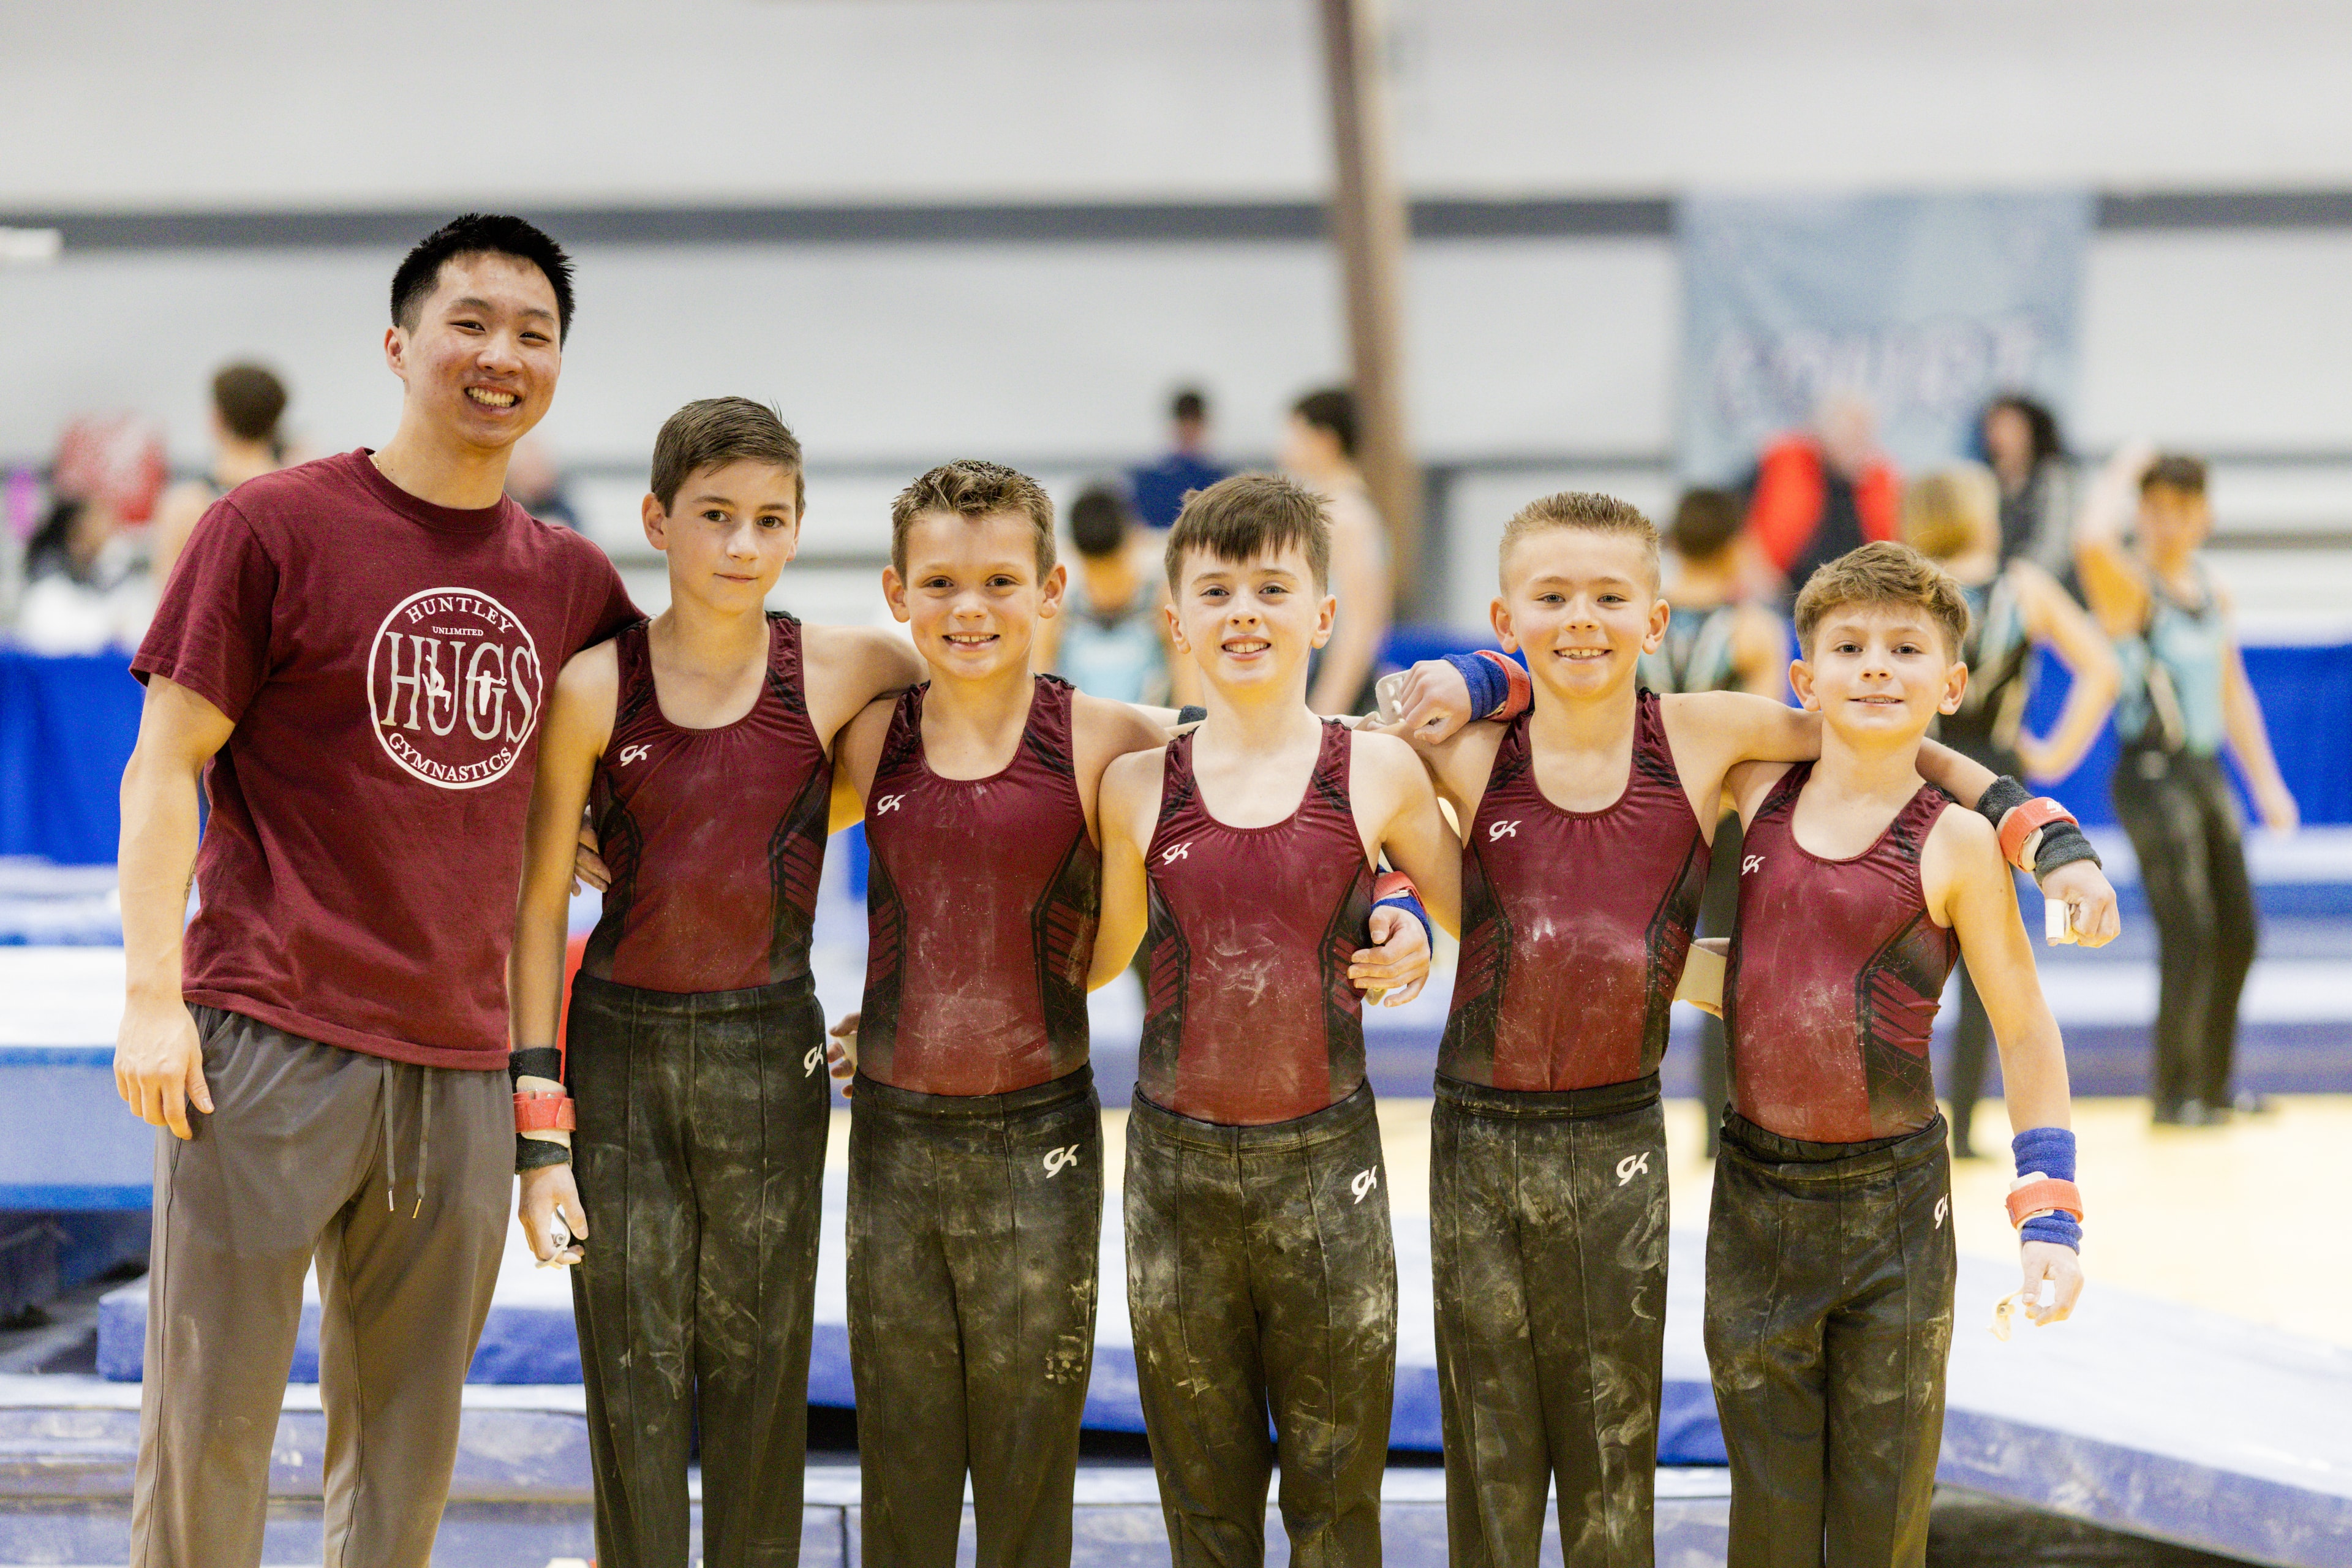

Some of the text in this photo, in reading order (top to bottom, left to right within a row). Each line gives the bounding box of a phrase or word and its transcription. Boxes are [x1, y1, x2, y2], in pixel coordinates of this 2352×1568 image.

[405, 597, 514, 633] HUNTLEY
[432, 626, 484, 636] UNLIMITED
[380, 631, 532, 743] HUGS
[389, 733, 512, 782] GYMNASTICS
